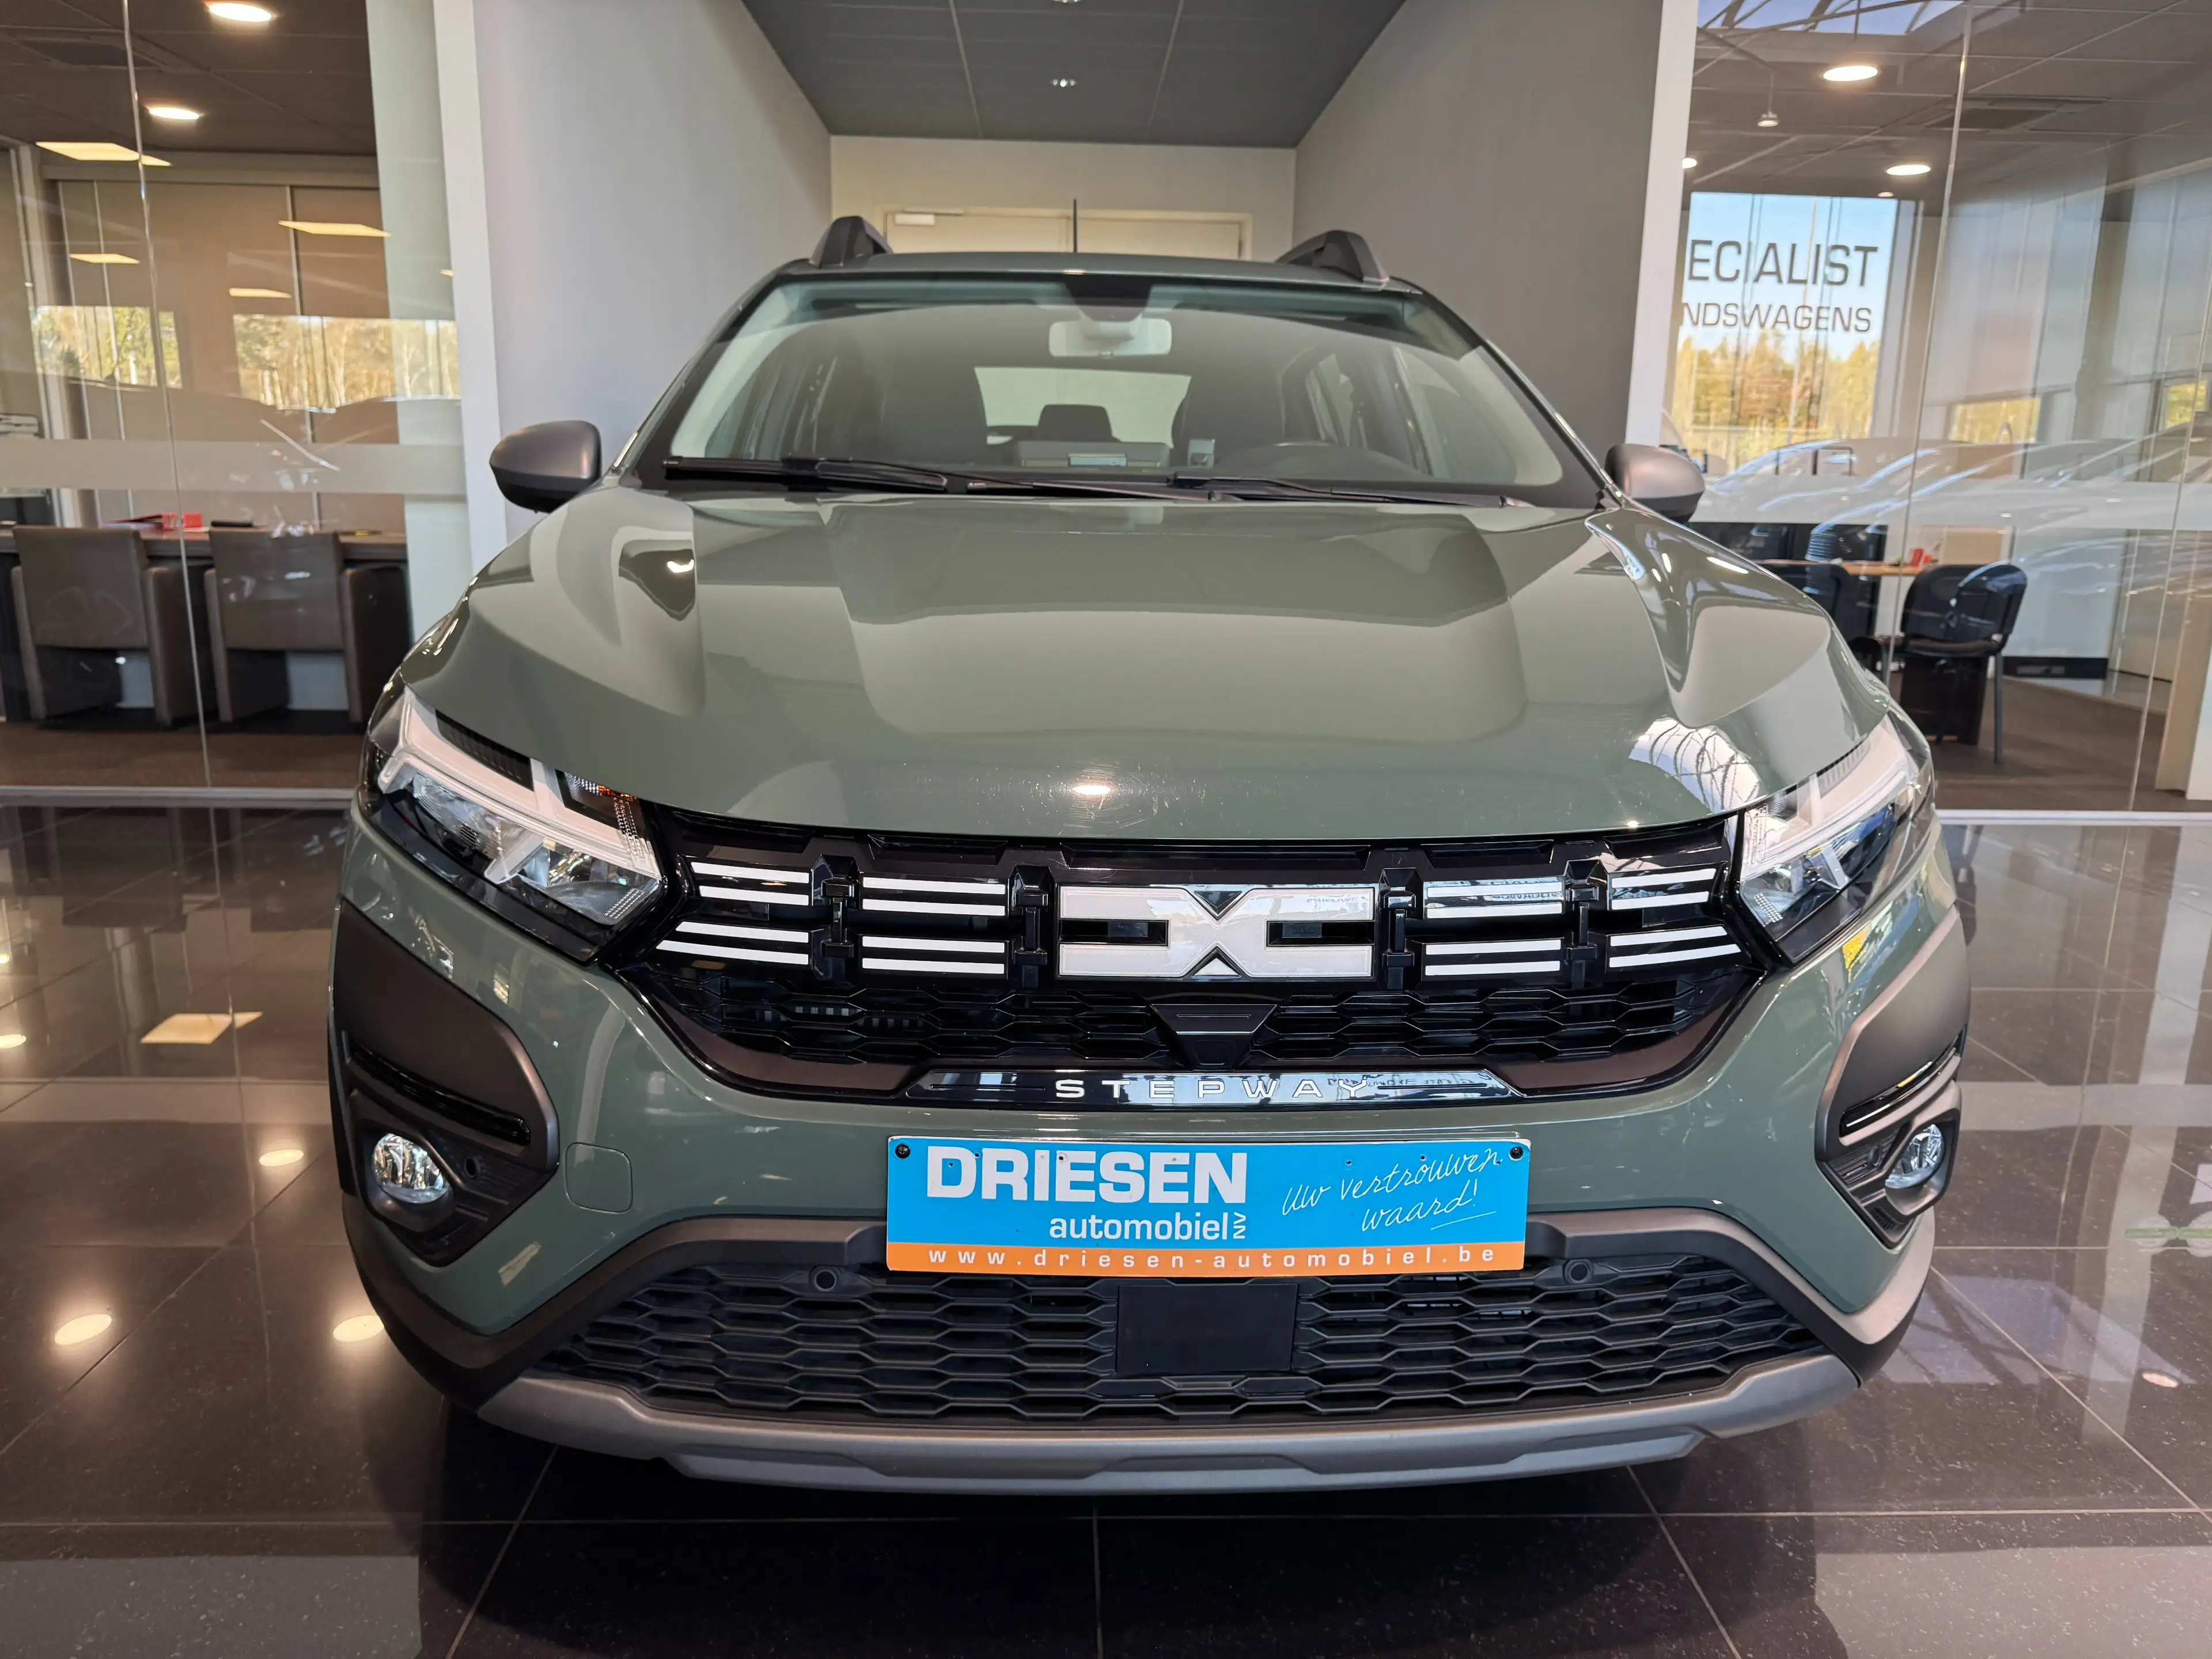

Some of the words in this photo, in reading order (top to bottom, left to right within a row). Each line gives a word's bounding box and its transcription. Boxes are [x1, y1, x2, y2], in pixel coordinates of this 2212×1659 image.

[1687, 238, 1880, 287] ECIALIST
[1055, 1079, 1368, 1099] STEPWAY
[927, 1145, 1248, 1204] DRIESEN
[1340, 1147, 1503, 1200] vertrouwen
[1361, 1178, 1478, 1232] waard!
[1049, 1211, 1229, 1240] automobiel
[1233, 1211, 1247, 1239] NV
[928, 1245, 1495, 1268] www.driesen-automobiel.be
